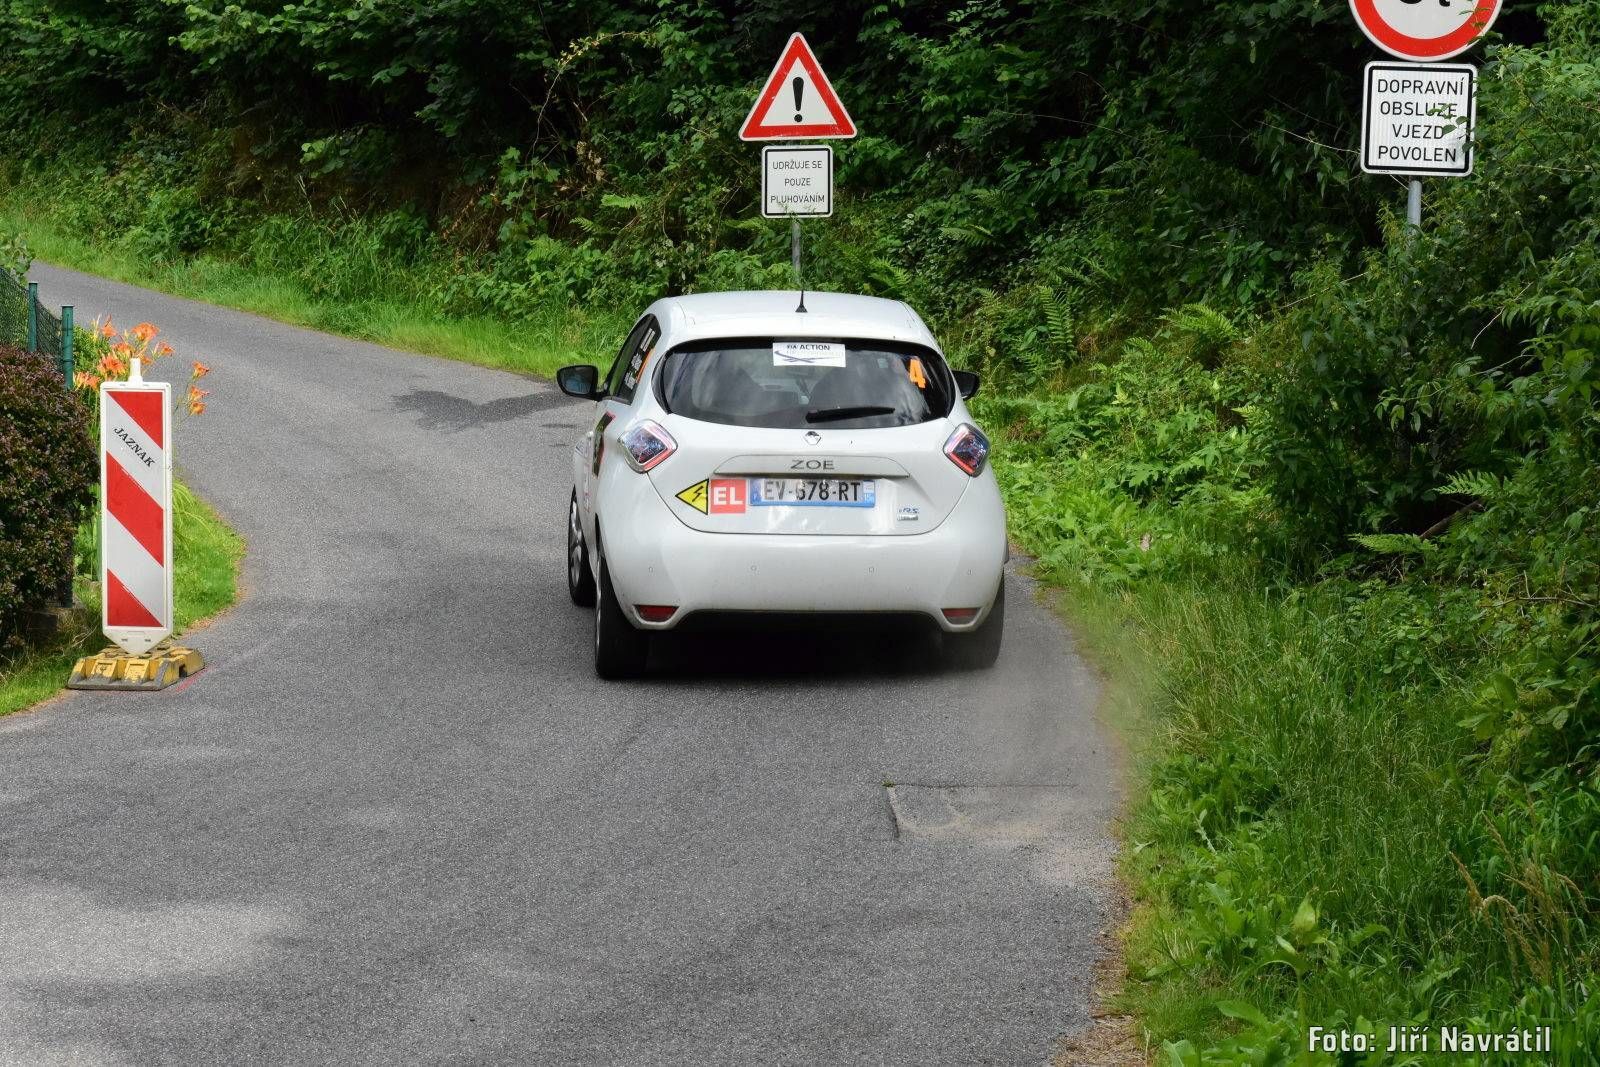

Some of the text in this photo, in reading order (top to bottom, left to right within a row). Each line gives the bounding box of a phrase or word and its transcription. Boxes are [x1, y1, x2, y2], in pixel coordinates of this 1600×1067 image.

[1377, 77, 1464, 95] DOPRAVNÍ
[1392, 123, 1444, 139] VJEZD
[1378, 145, 1457, 162] POVOLEN
[772, 159, 823, 170] UDRŽUJE SE
[784, 177, 811, 187] POUZE
[770, 192, 825, 204] PLUHOVÁNÍM
[909, 359, 926, 389] 4
[113, 427, 156, 467] JAZNAK
[790, 459, 835, 470] ZOE
[713, 486, 744, 506] EL
